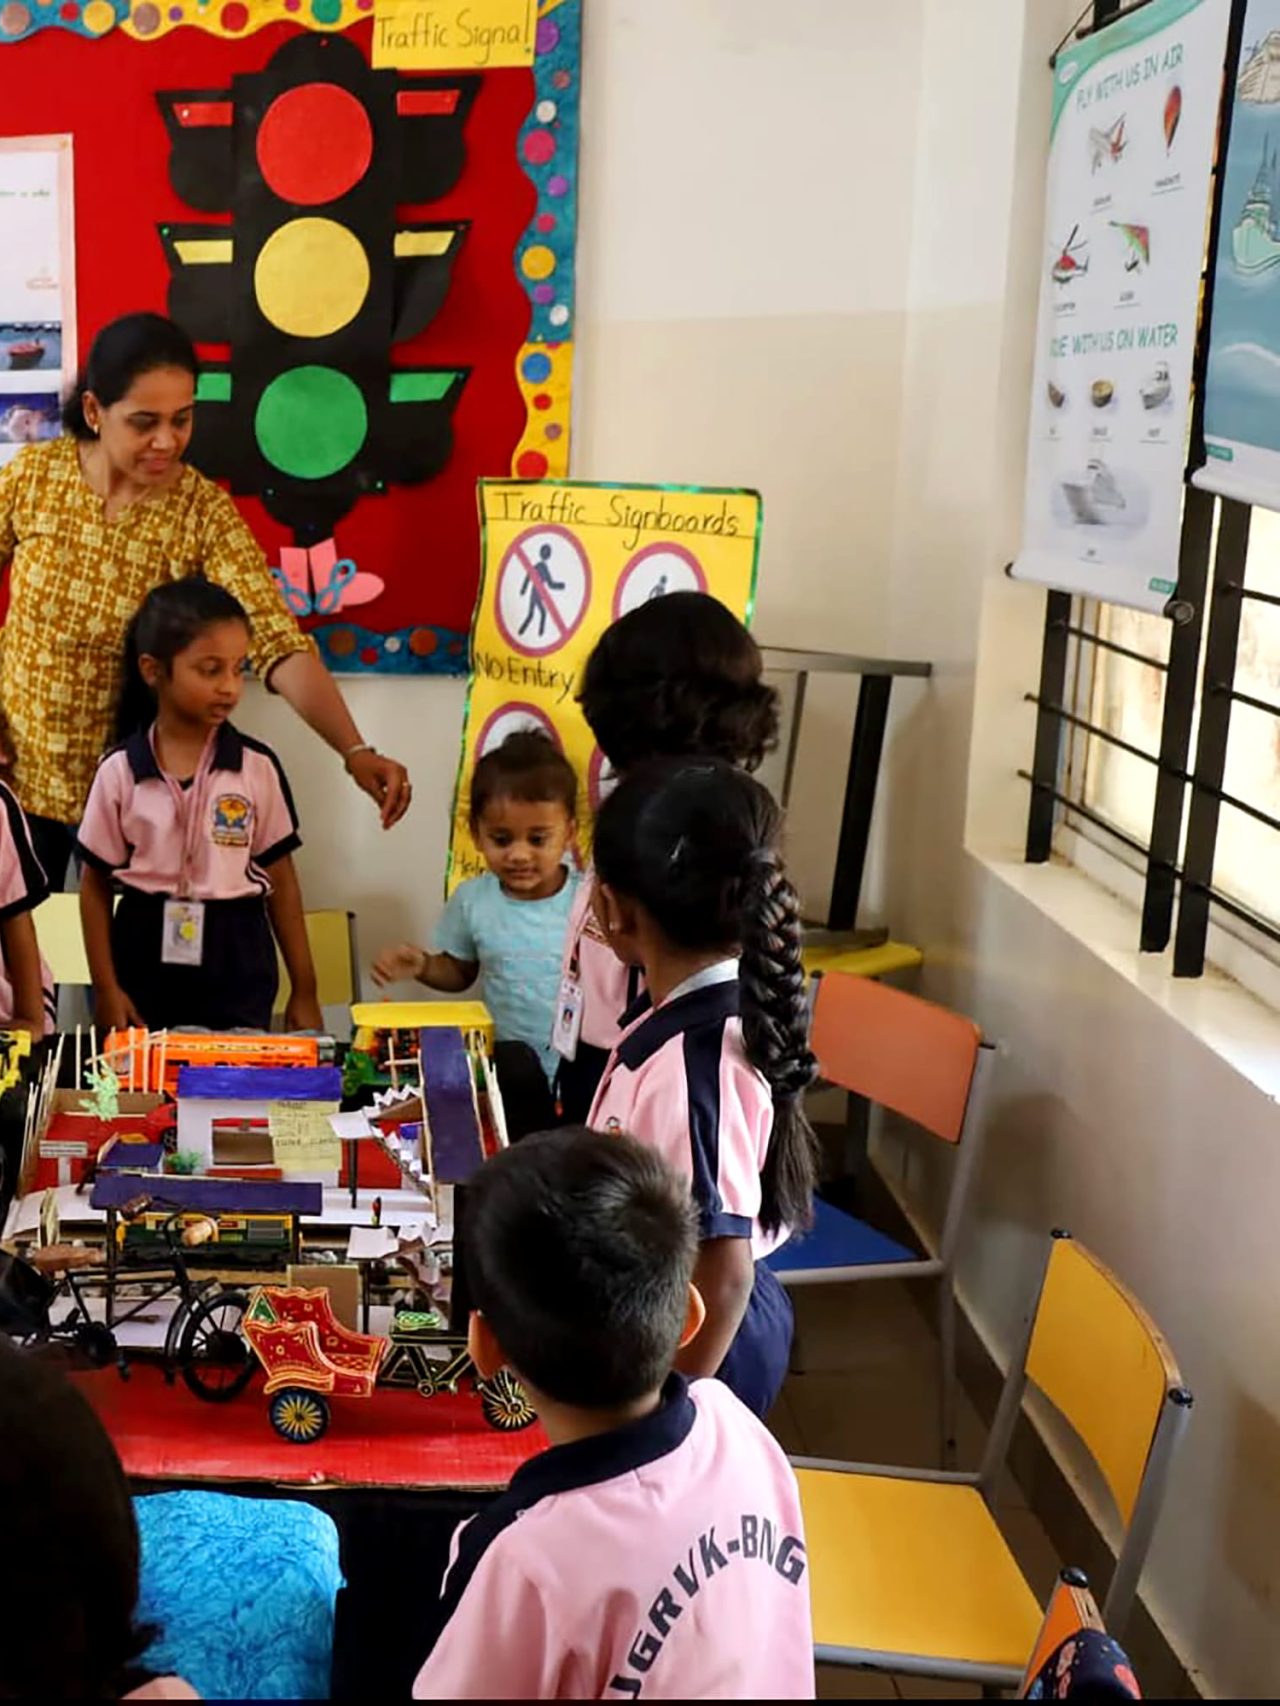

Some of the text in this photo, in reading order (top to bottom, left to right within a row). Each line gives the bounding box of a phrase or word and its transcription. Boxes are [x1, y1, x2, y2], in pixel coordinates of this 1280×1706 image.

[377, 0, 531, 65] Traffic Signal
[1096, 69, 1123, 102] WITH
[1124, 61, 1141, 88] US
[1142, 52, 1160, 81] IN
[1161, 42, 1183, 73] AIR
[1100, 330, 1115, 352] US
[1116, 325, 1135, 350] ON
[1137, 322, 1179, 348] WATER
[493, 489, 741, 551] Traffic Signboards
[507, 655, 576, 705] Entry
